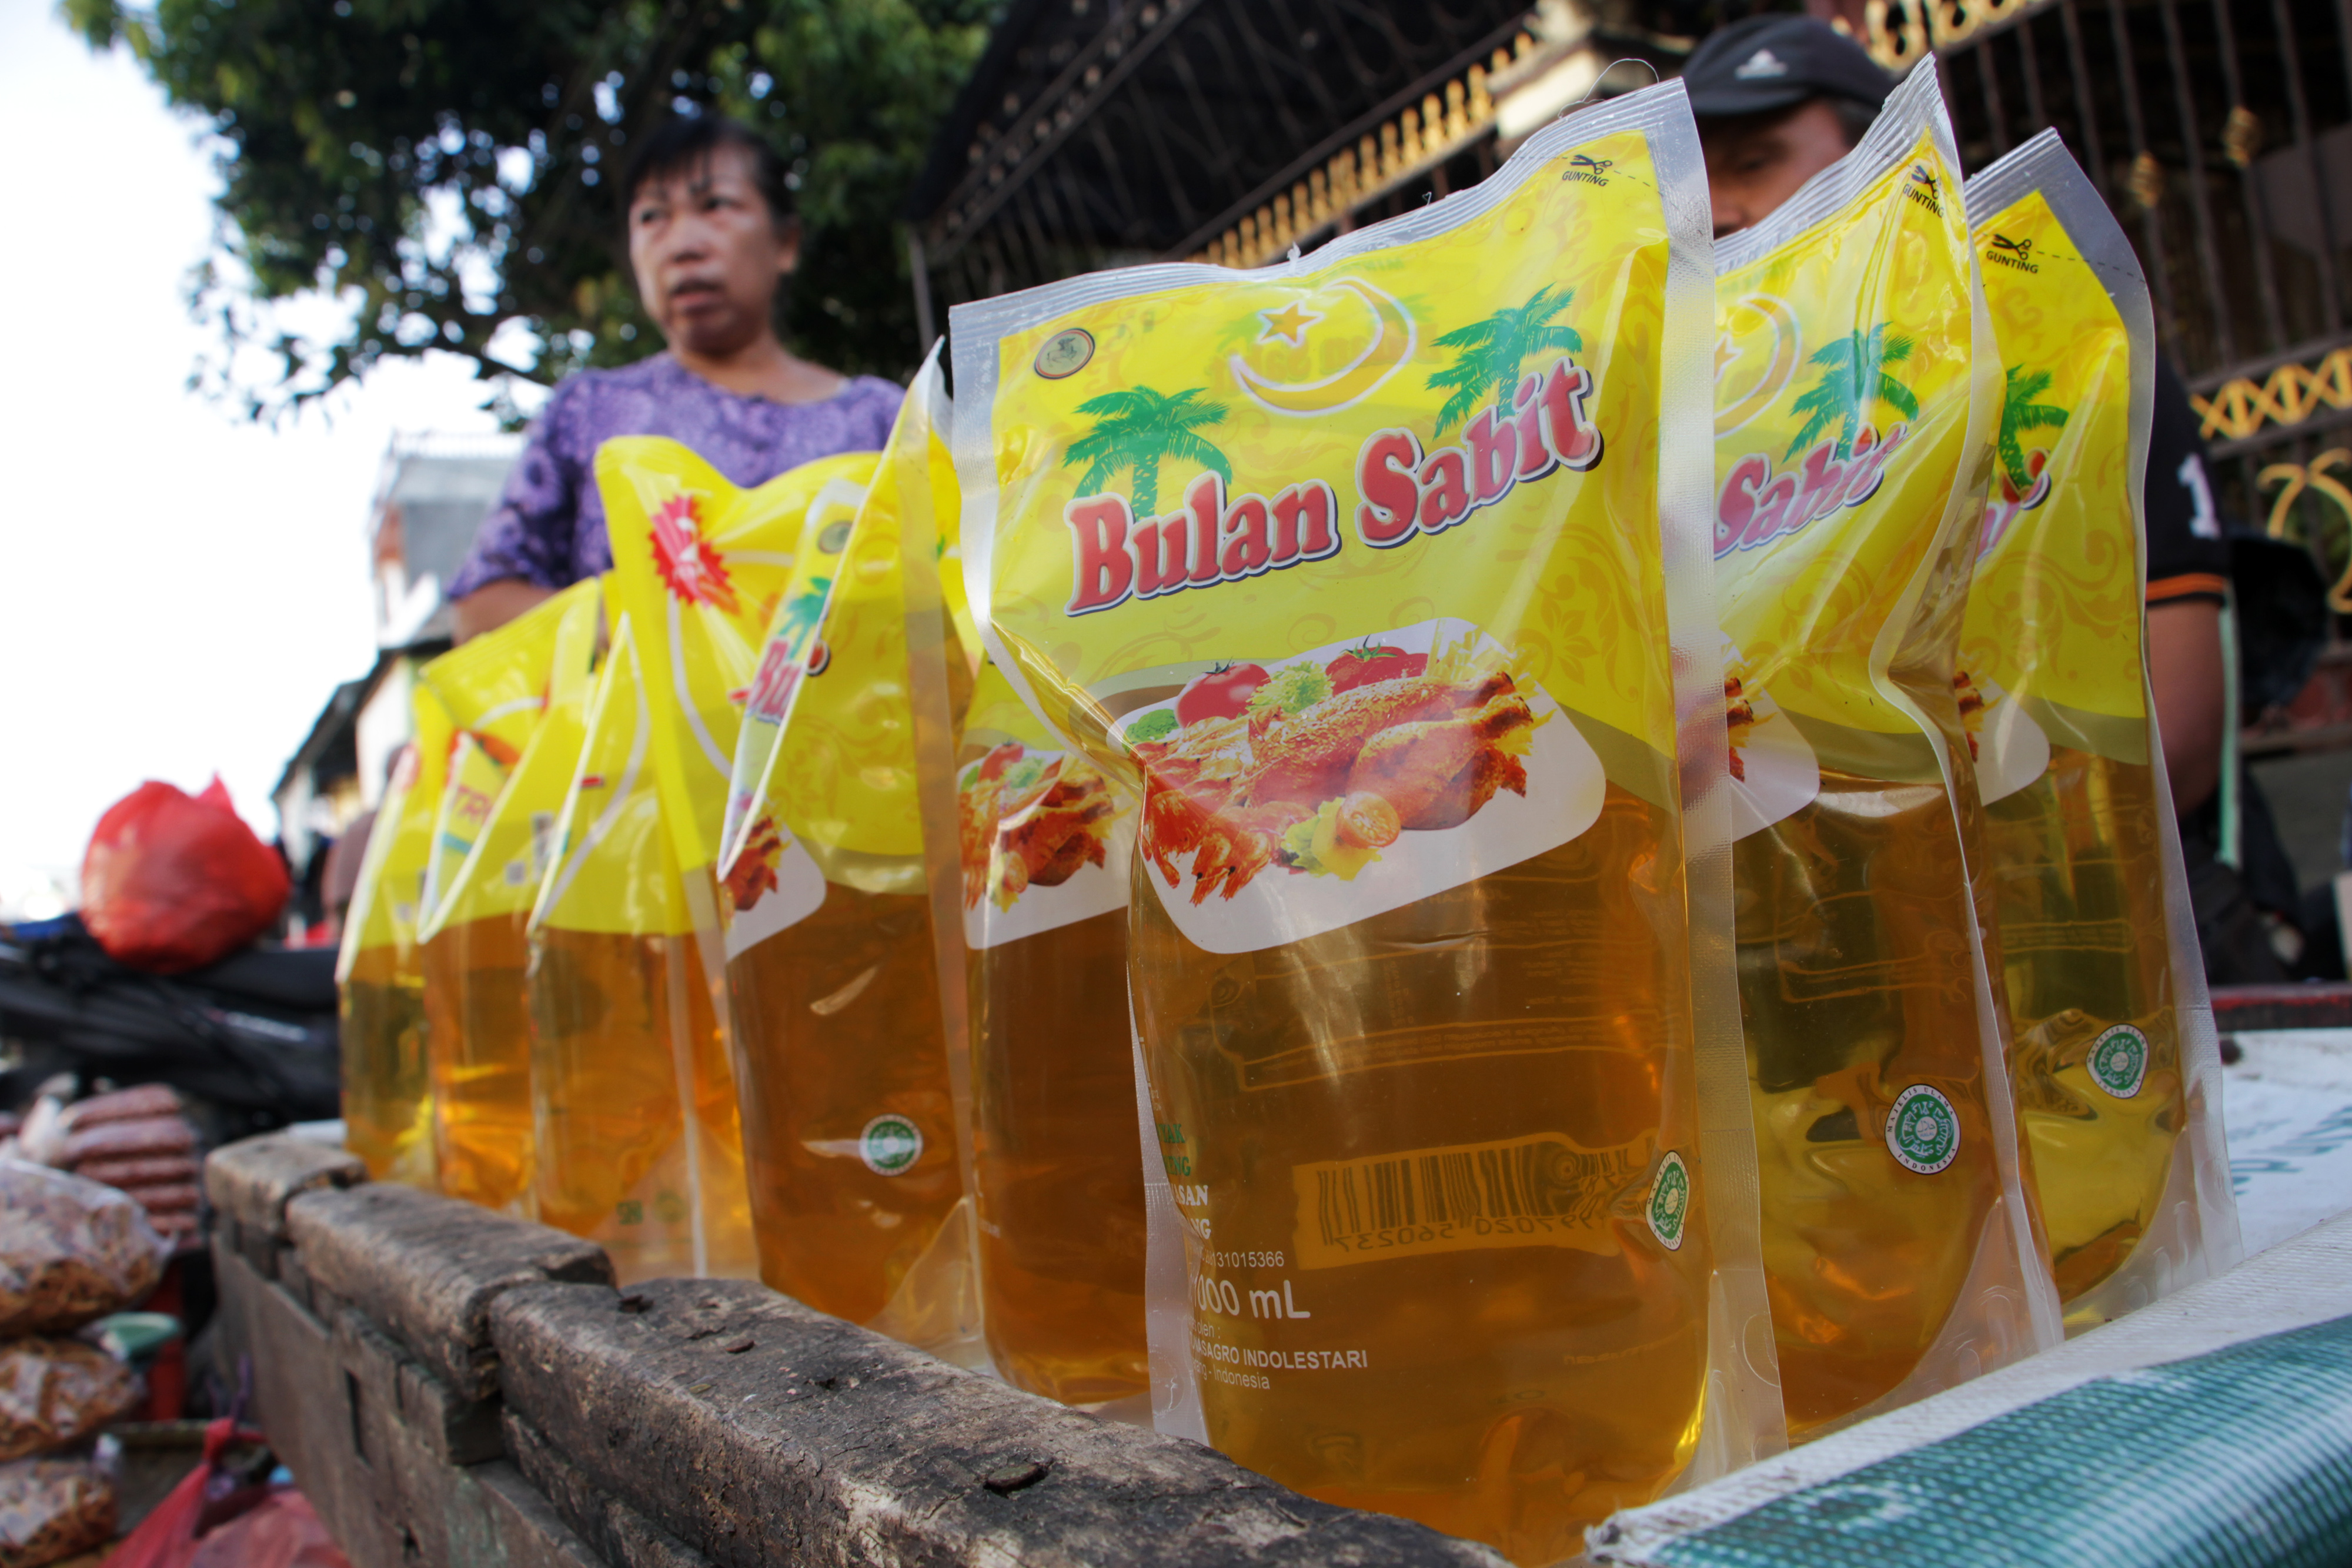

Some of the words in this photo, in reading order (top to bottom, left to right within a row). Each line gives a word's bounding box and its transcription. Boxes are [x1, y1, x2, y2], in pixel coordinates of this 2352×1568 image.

[1562, 170, 1609, 186] GUNTING
[1903, 183, 1945, 218] GUNTING
[1986, 250, 2039, 274] GUNTING
[1063, 470, 1340, 617] Bulan
[1355, 357, 1604, 550] Sabit
[1887, 1087, 1918, 1132] MAJELIS
[1924, 1087, 1953, 1115] ULAMA
[1157, 1124, 1185, 1144] YAK
[1897, 1148, 1956, 1172] INDONESIA
[1173, 1185, 1208, 1206] ASAN
[1249, 1279, 1311, 1319] mL
[1243, 1349, 1368, 1370] INDOLESTARI
[1214, 1367, 1271, 1390] Indonesia
